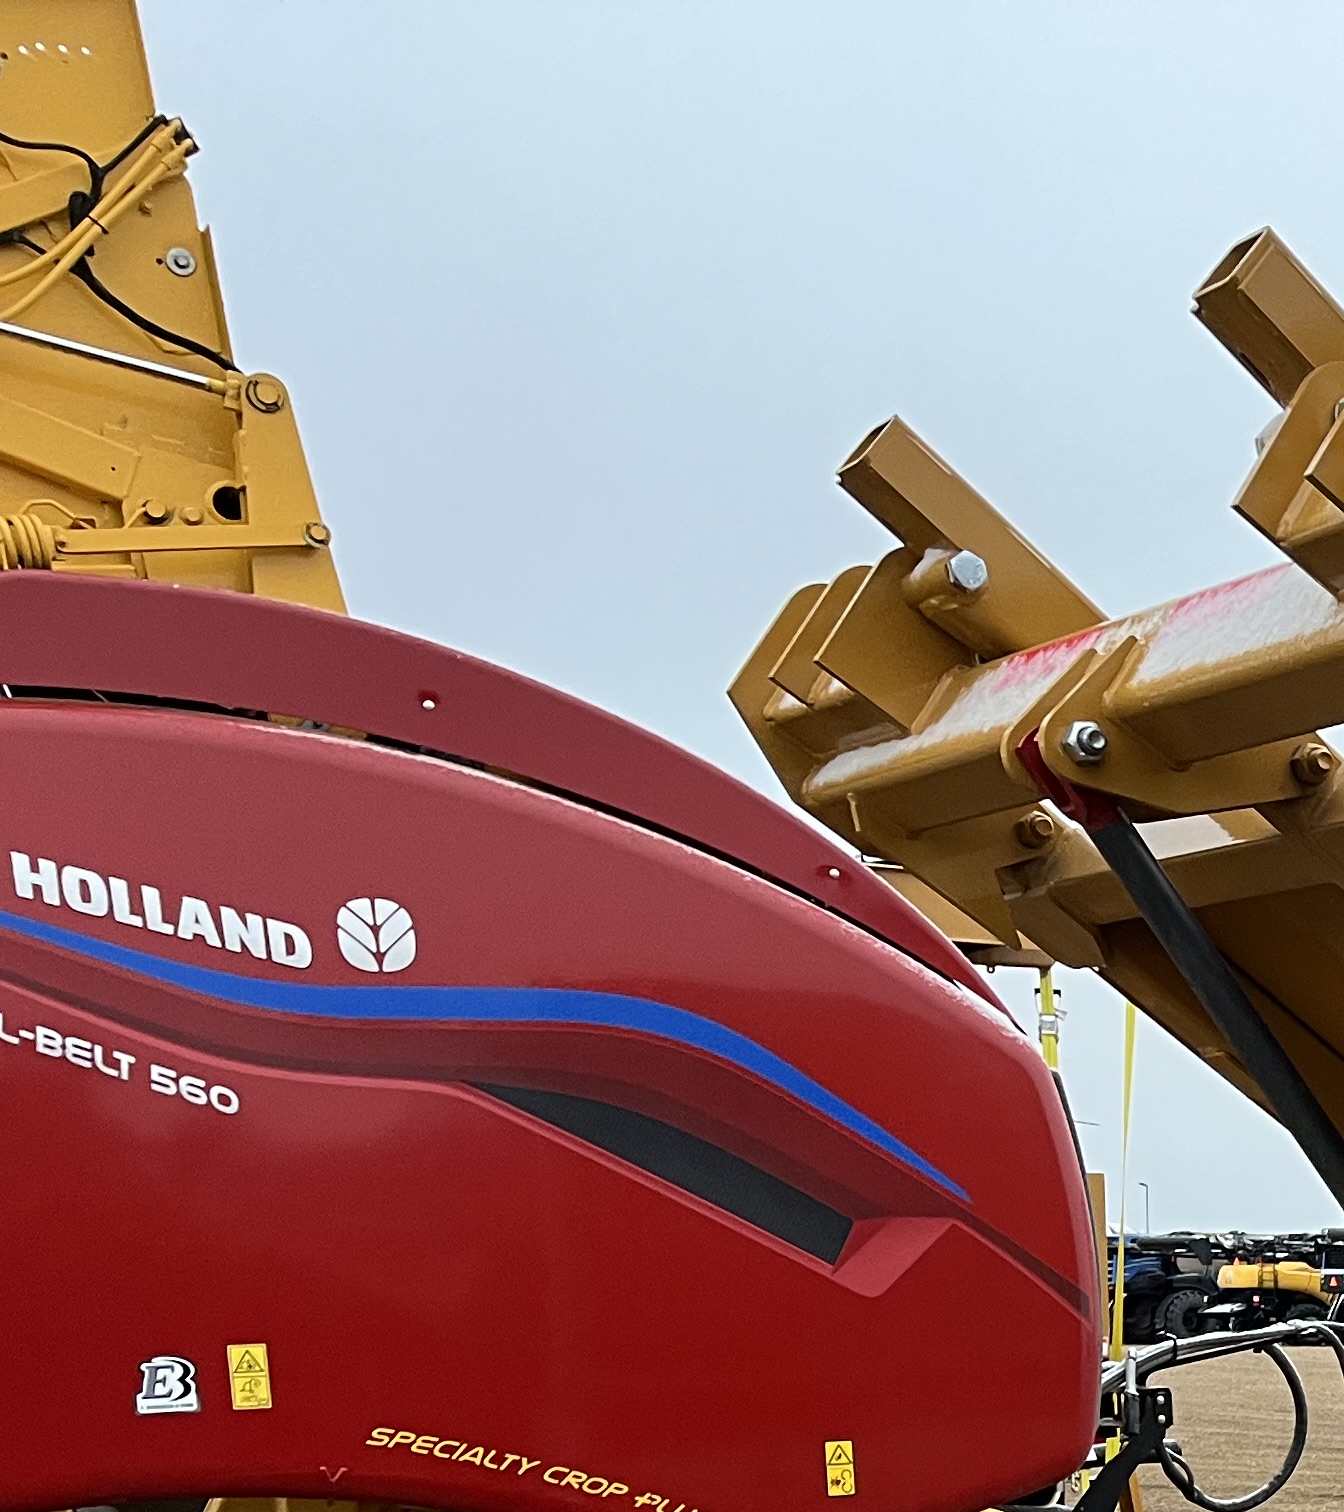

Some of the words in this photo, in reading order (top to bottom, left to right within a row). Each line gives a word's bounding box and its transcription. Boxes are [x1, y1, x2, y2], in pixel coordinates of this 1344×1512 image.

[9, 850, 313, 969] HOLLAND
[150, 1063, 240, 1115] 560
[365, 1427, 541, 1476] SPECIALTY
[542, 1466, 630, 1498] CROP
